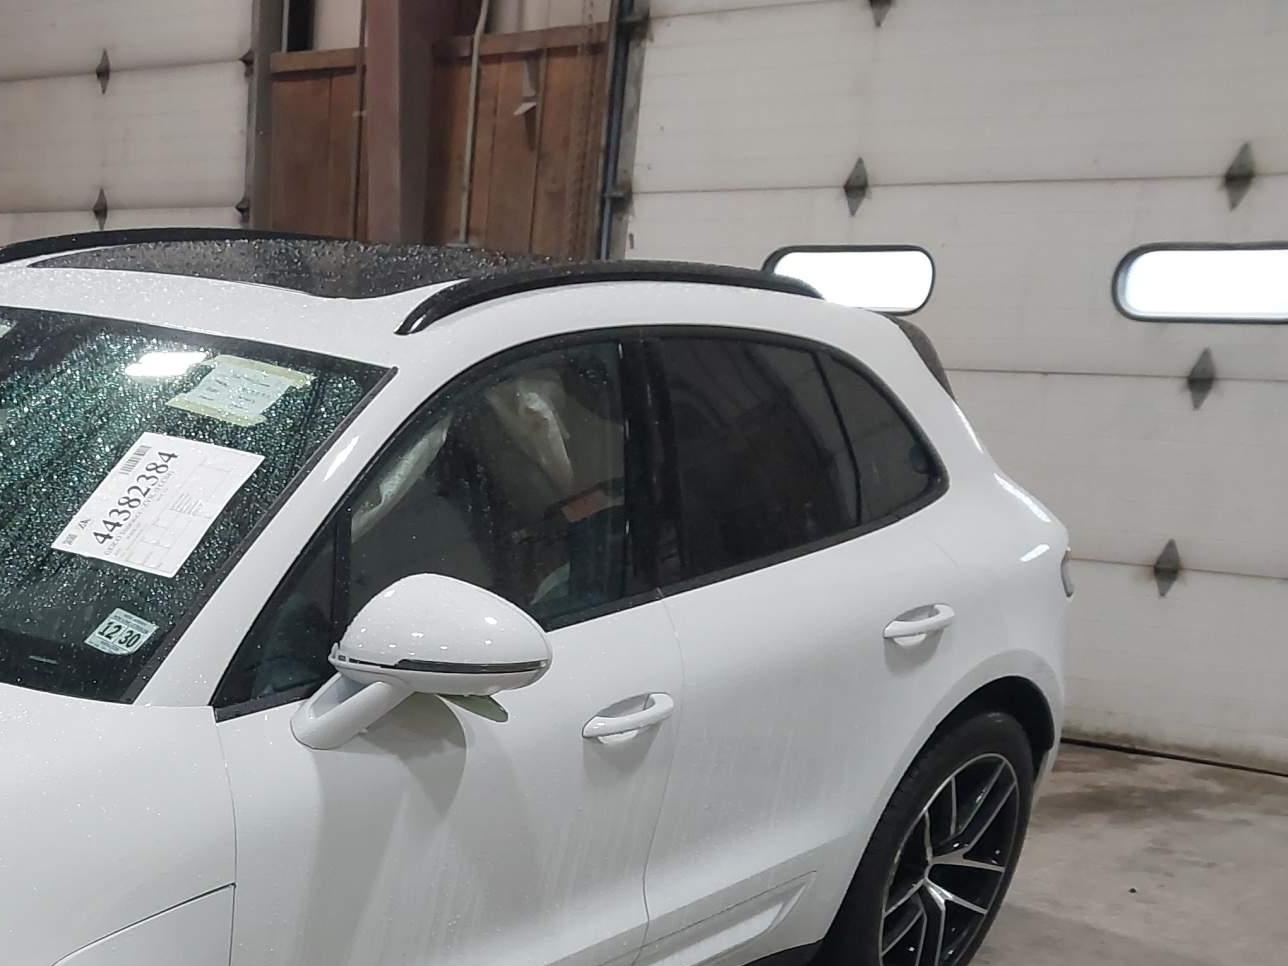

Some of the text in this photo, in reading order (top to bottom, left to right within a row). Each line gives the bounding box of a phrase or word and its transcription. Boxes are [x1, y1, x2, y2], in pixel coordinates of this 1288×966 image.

[93, 452, 178, 544] 44382384
[98, 622, 123, 640] 12
[118, 630, 141, 648] 30
